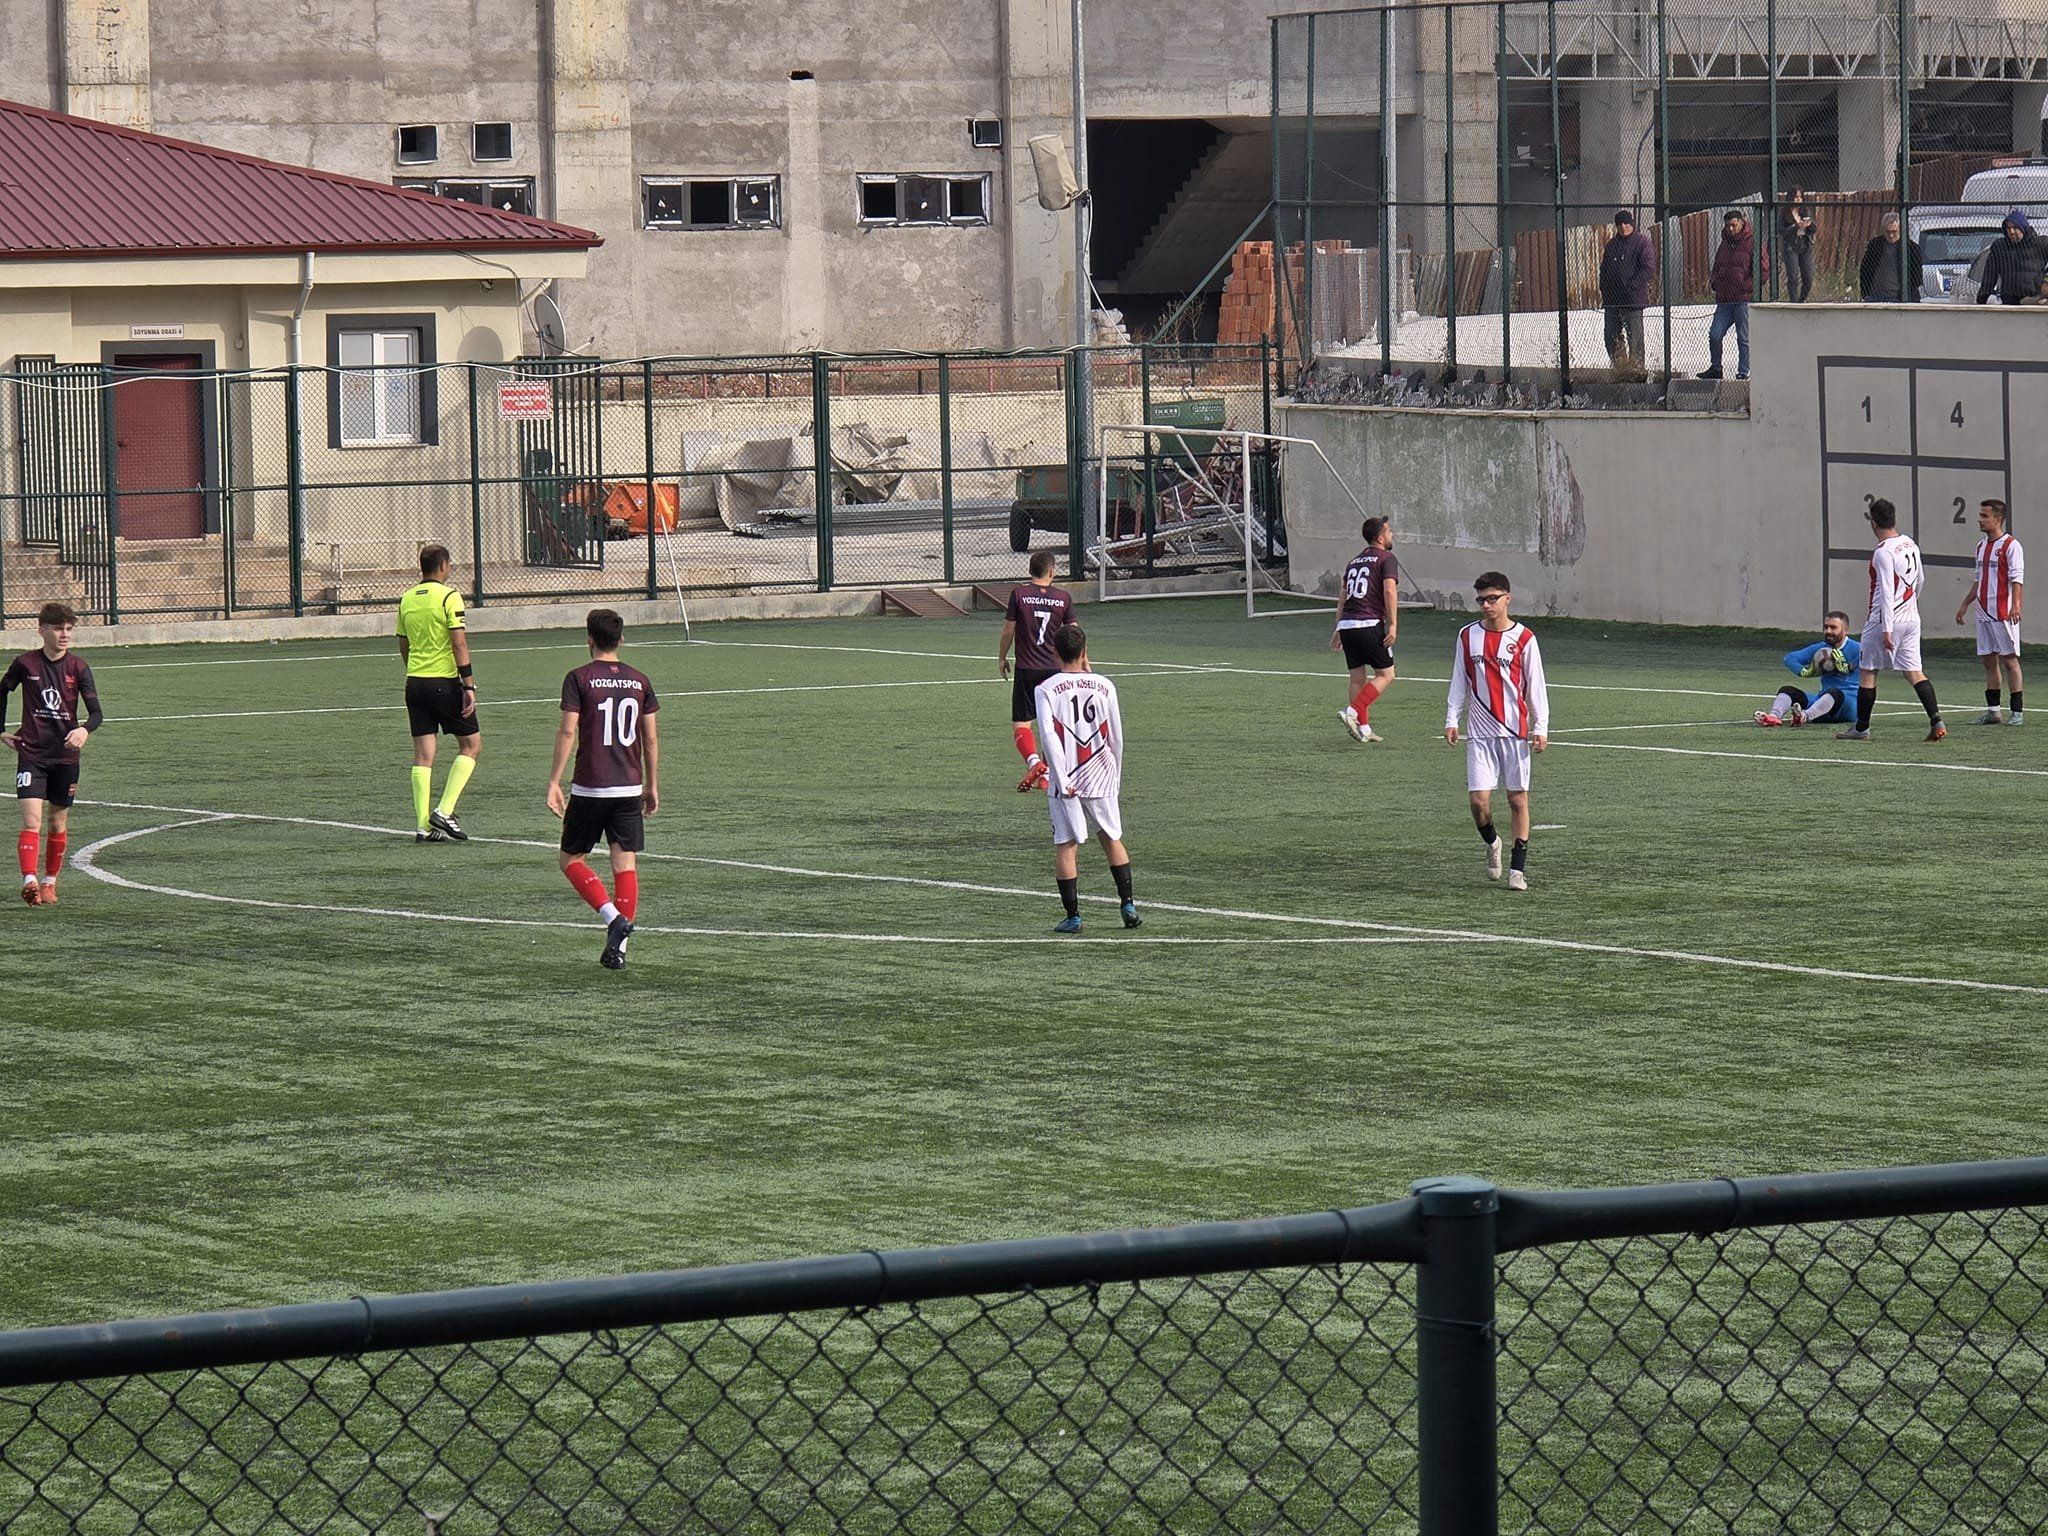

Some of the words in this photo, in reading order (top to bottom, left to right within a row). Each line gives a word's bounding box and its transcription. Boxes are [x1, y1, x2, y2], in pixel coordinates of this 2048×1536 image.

[1861, 395, 1871, 423] 1
[1950, 401, 1964, 428] 4
[1952, 496, 1966, 524] 2
[1346, 566, 1370, 600] 66
[1022, 596, 1065, 607] YOZGATSPOR
[1034, 610, 1051, 646] 7
[590, 679, 642, 690] YOZGATSPOR
[598, 697, 639, 747] 10
[1071, 694, 1095, 724] 16
[16, 771, 32, 788] 20
